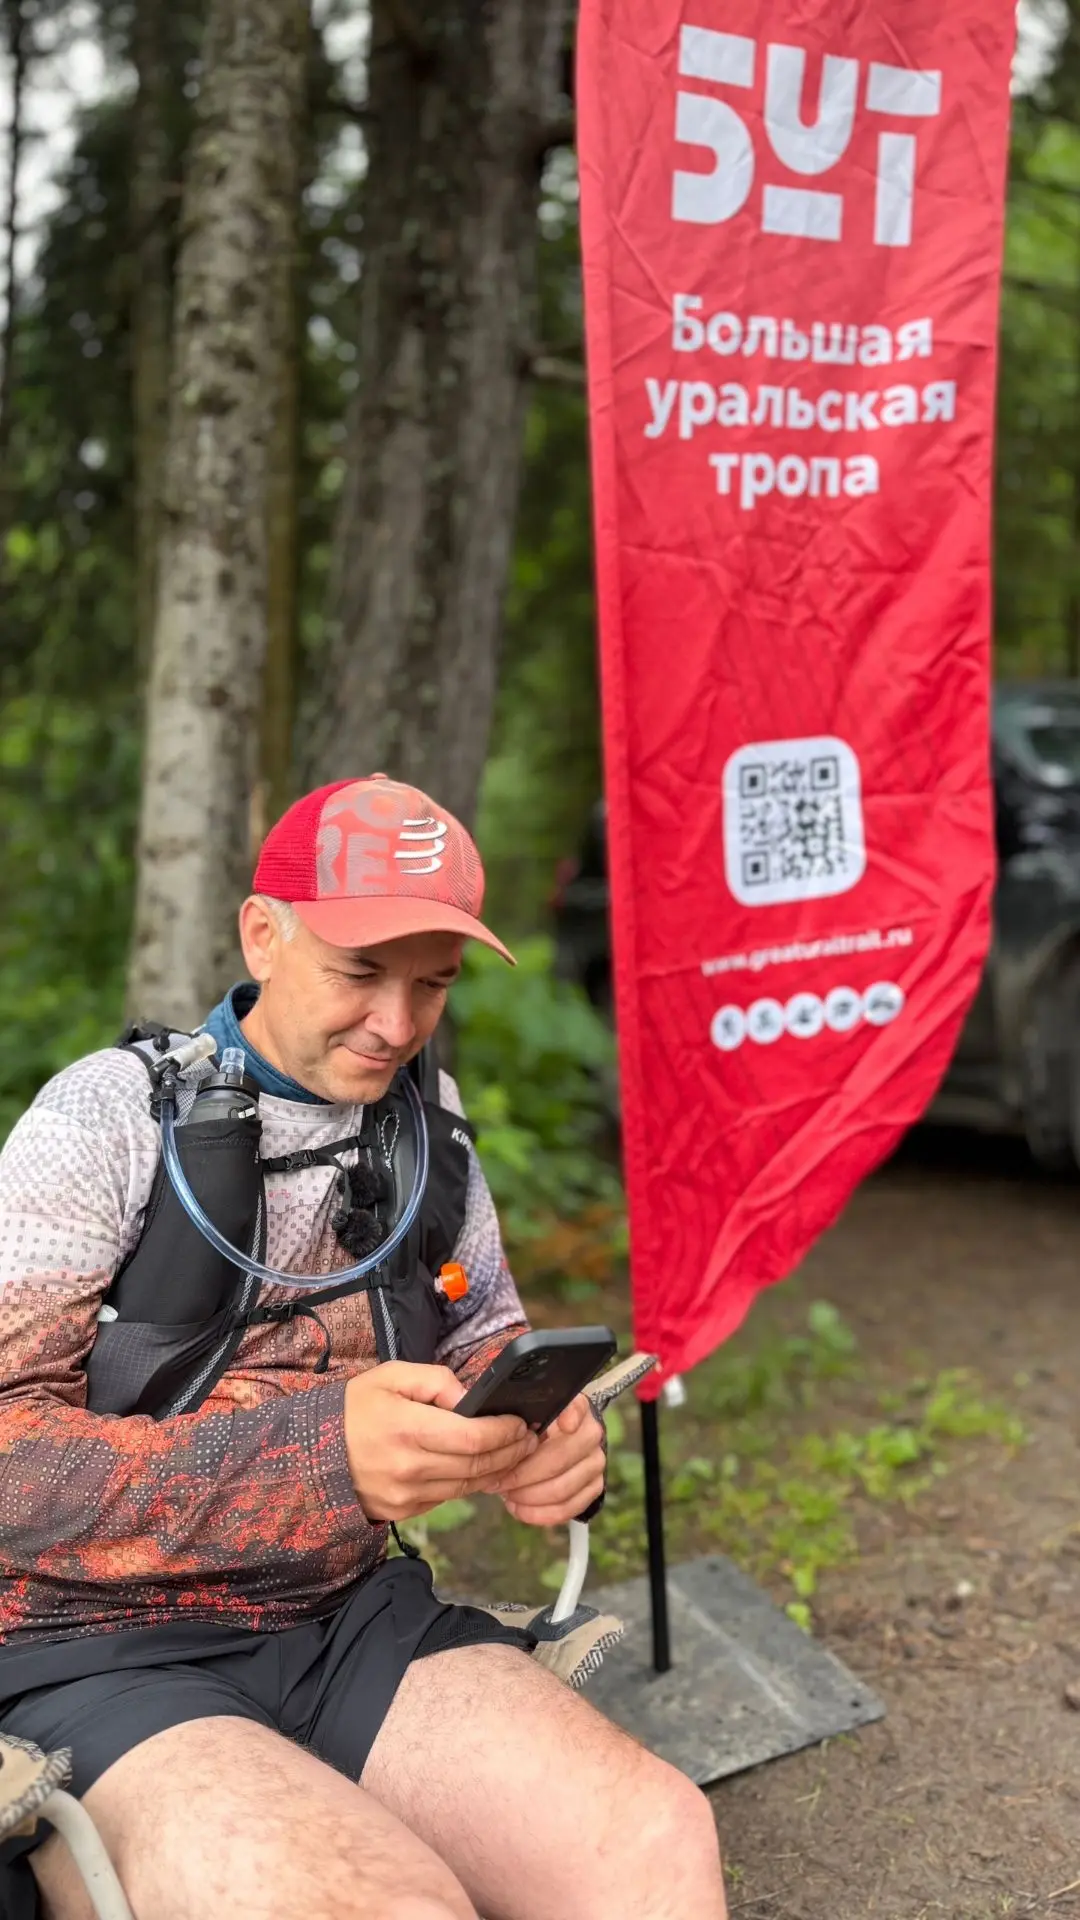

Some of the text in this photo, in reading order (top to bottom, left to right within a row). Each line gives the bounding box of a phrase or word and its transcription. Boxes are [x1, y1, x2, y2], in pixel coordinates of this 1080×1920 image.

[672, 293, 934, 367] Большая
[643, 376, 958, 440] уральская
[708, 452, 881, 511] тропа
